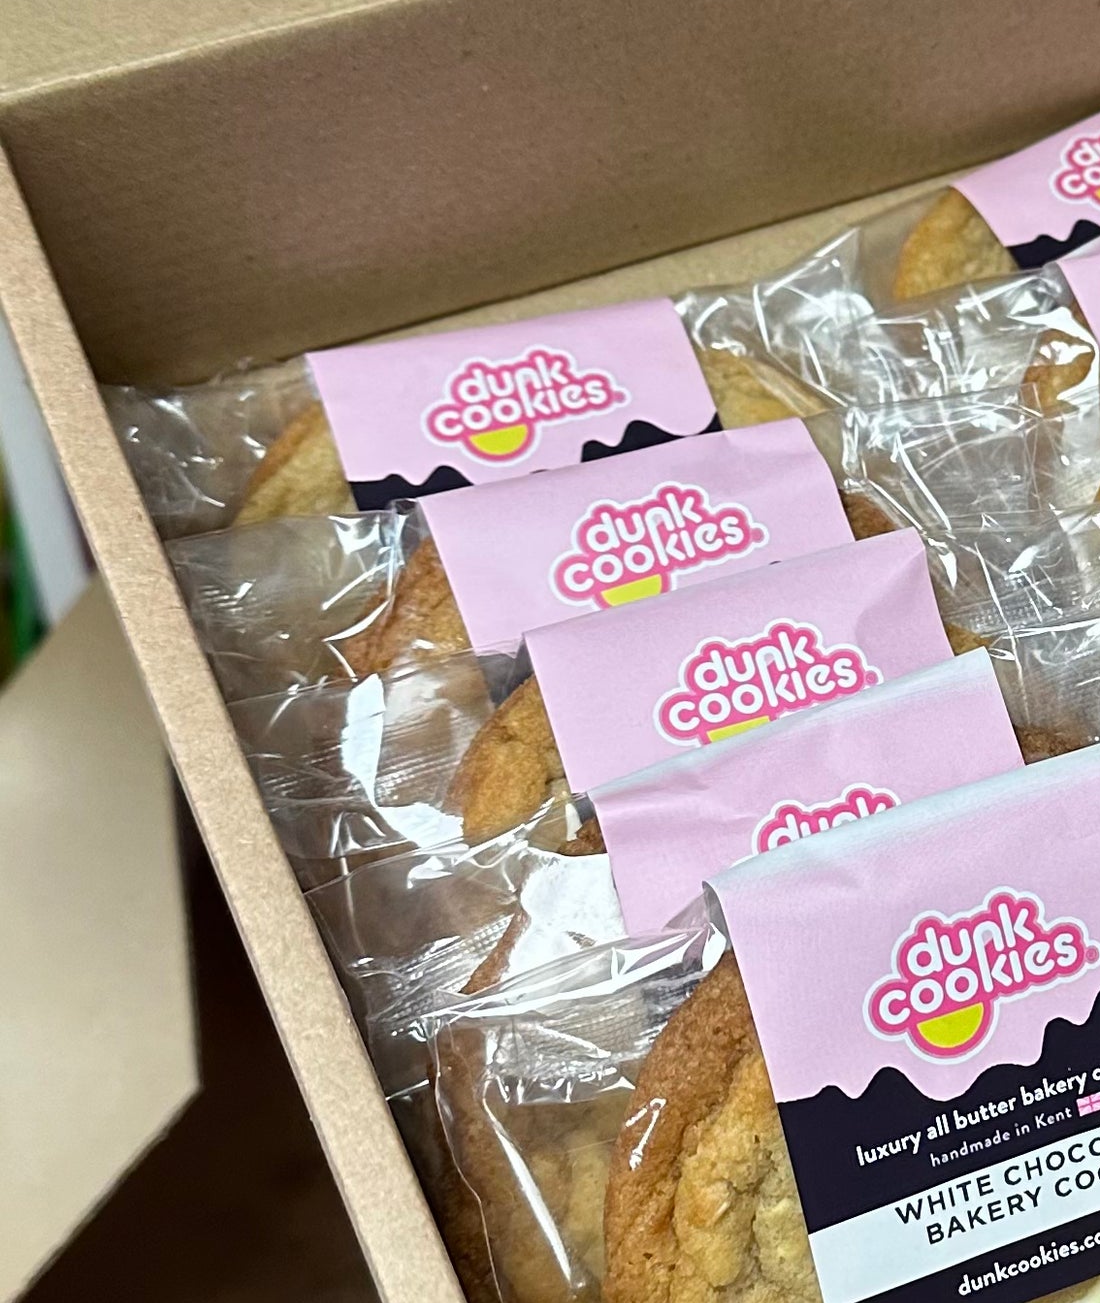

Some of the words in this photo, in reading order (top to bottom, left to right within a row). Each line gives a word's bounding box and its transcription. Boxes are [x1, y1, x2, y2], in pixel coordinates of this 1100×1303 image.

[434, 380, 607, 436] cookies
[458, 355, 568, 403] dunk
[586, 493, 702, 552] dunk
[564, 516, 744, 592] cookies
[694, 632, 814, 690] dunk
[669, 658, 857, 731] cookies
[907, 903, 1035, 976] dunk
[879, 933, 1077, 1024] cookies
[856, 1128, 921, 1166] luxury
[927, 1113, 950, 1140] all
[954, 1097, 1016, 1129] butter
[1021, 1073, 1087, 1106] bakery
[930, 1130, 1011, 1167] handmade
[1014, 1122, 1030, 1137] in
[1035, 1107, 1072, 1128] Kent
[895, 1174, 994, 1224] WHITE
[926, 1187, 1042, 1245] BAKERY
